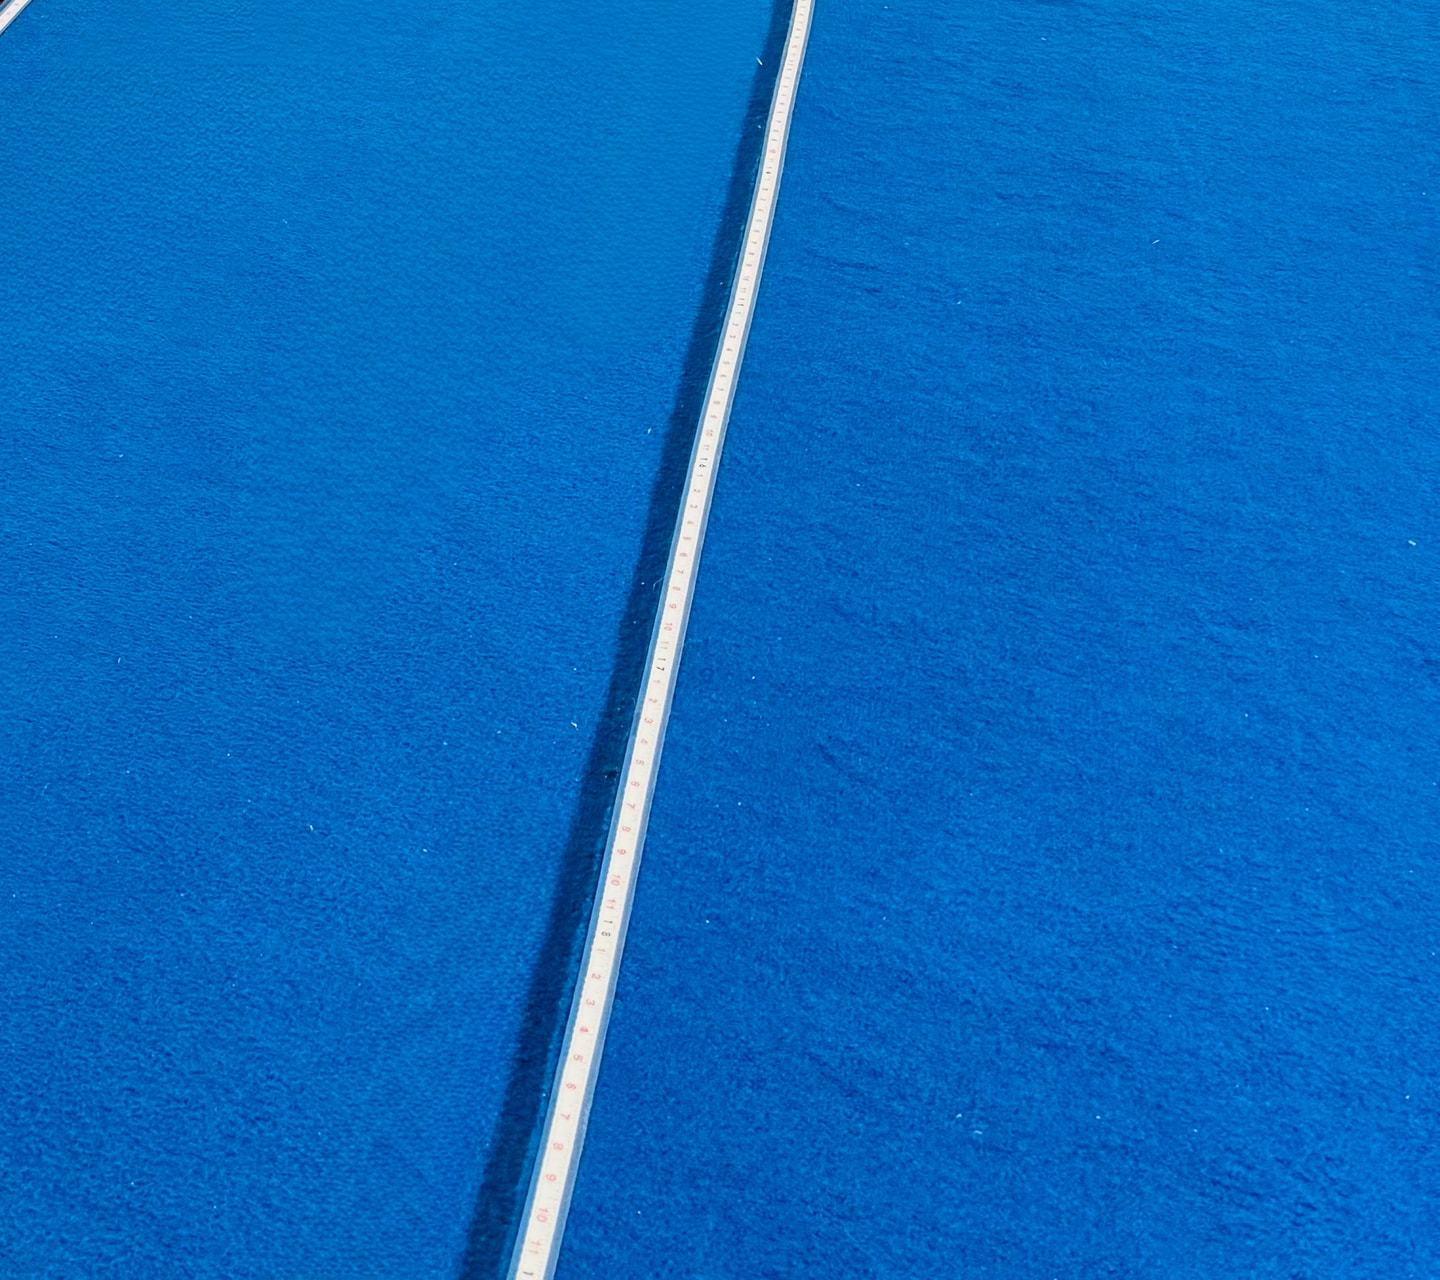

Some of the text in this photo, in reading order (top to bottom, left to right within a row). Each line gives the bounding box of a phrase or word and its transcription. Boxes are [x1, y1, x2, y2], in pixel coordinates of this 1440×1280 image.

[616, 848, 627, 856] 9
[591, 972, 602, 980] 2
[572, 1054, 583, 1062] 5
[566, 1082, 577, 1090] 6
[560, 1113, 571, 1121] 7
[552, 1142, 563, 1151] 8
[545, 1174, 557, 1182] 9
